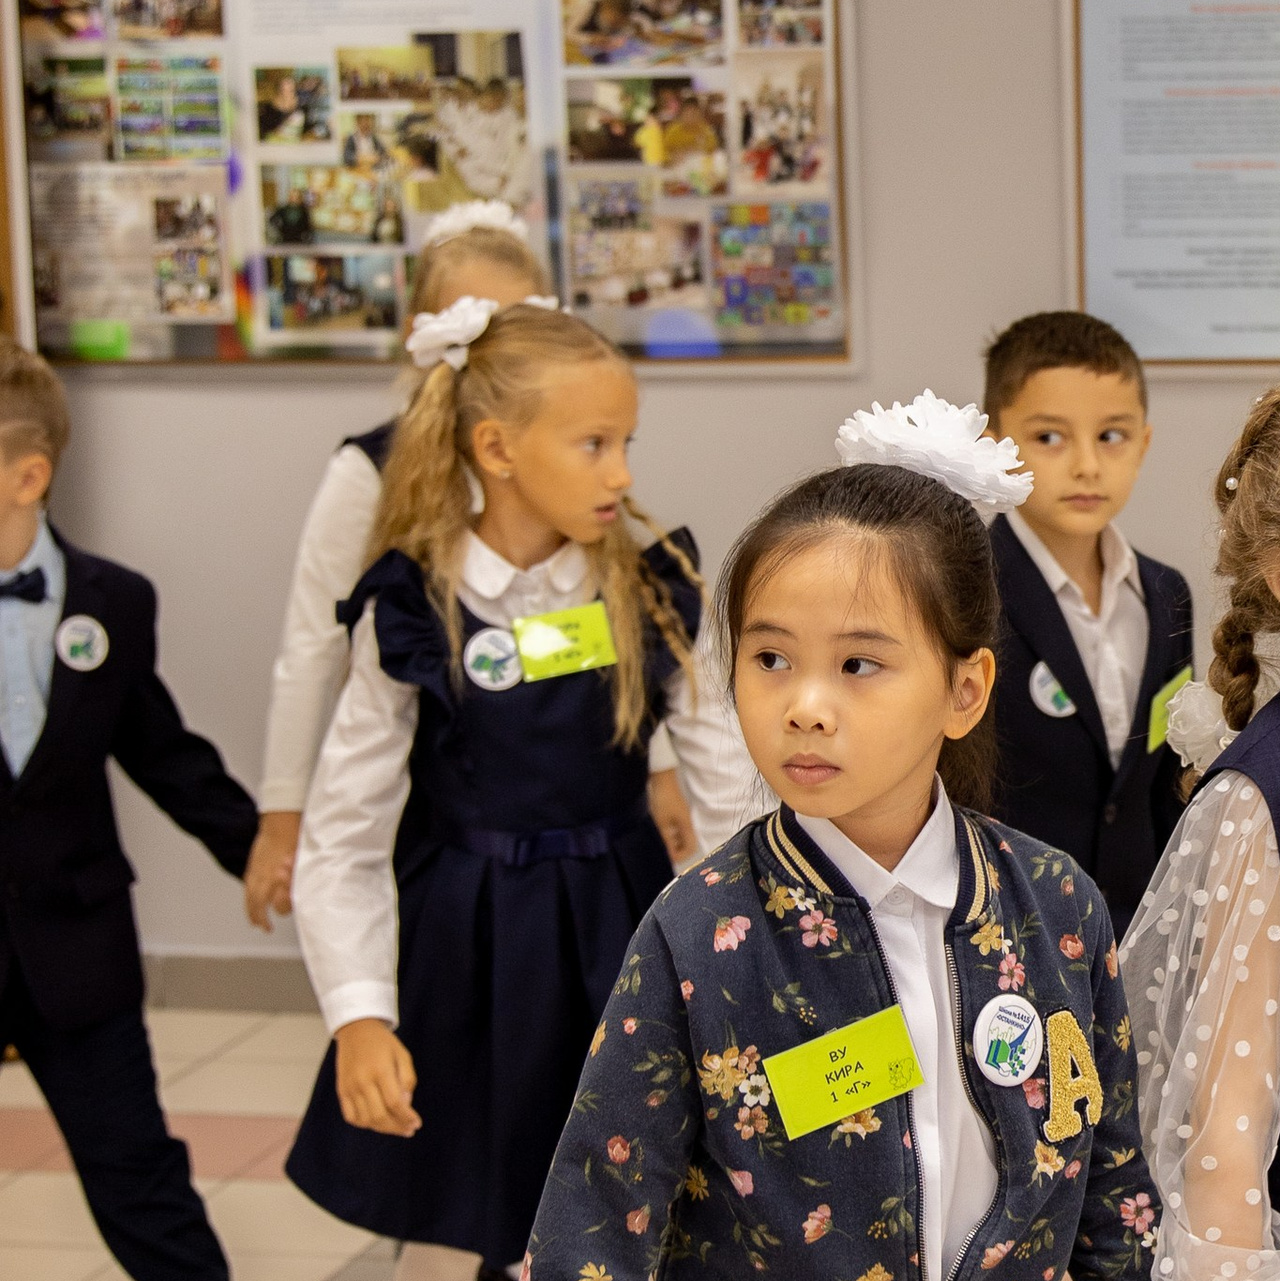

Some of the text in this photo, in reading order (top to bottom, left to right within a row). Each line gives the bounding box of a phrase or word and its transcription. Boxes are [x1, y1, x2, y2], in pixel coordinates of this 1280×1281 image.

[828, 1045, 847, 1063] ВУ
[825, 1061, 864, 1085] КИРА
[830, 1080, 872, 1103] 1 «Г»
